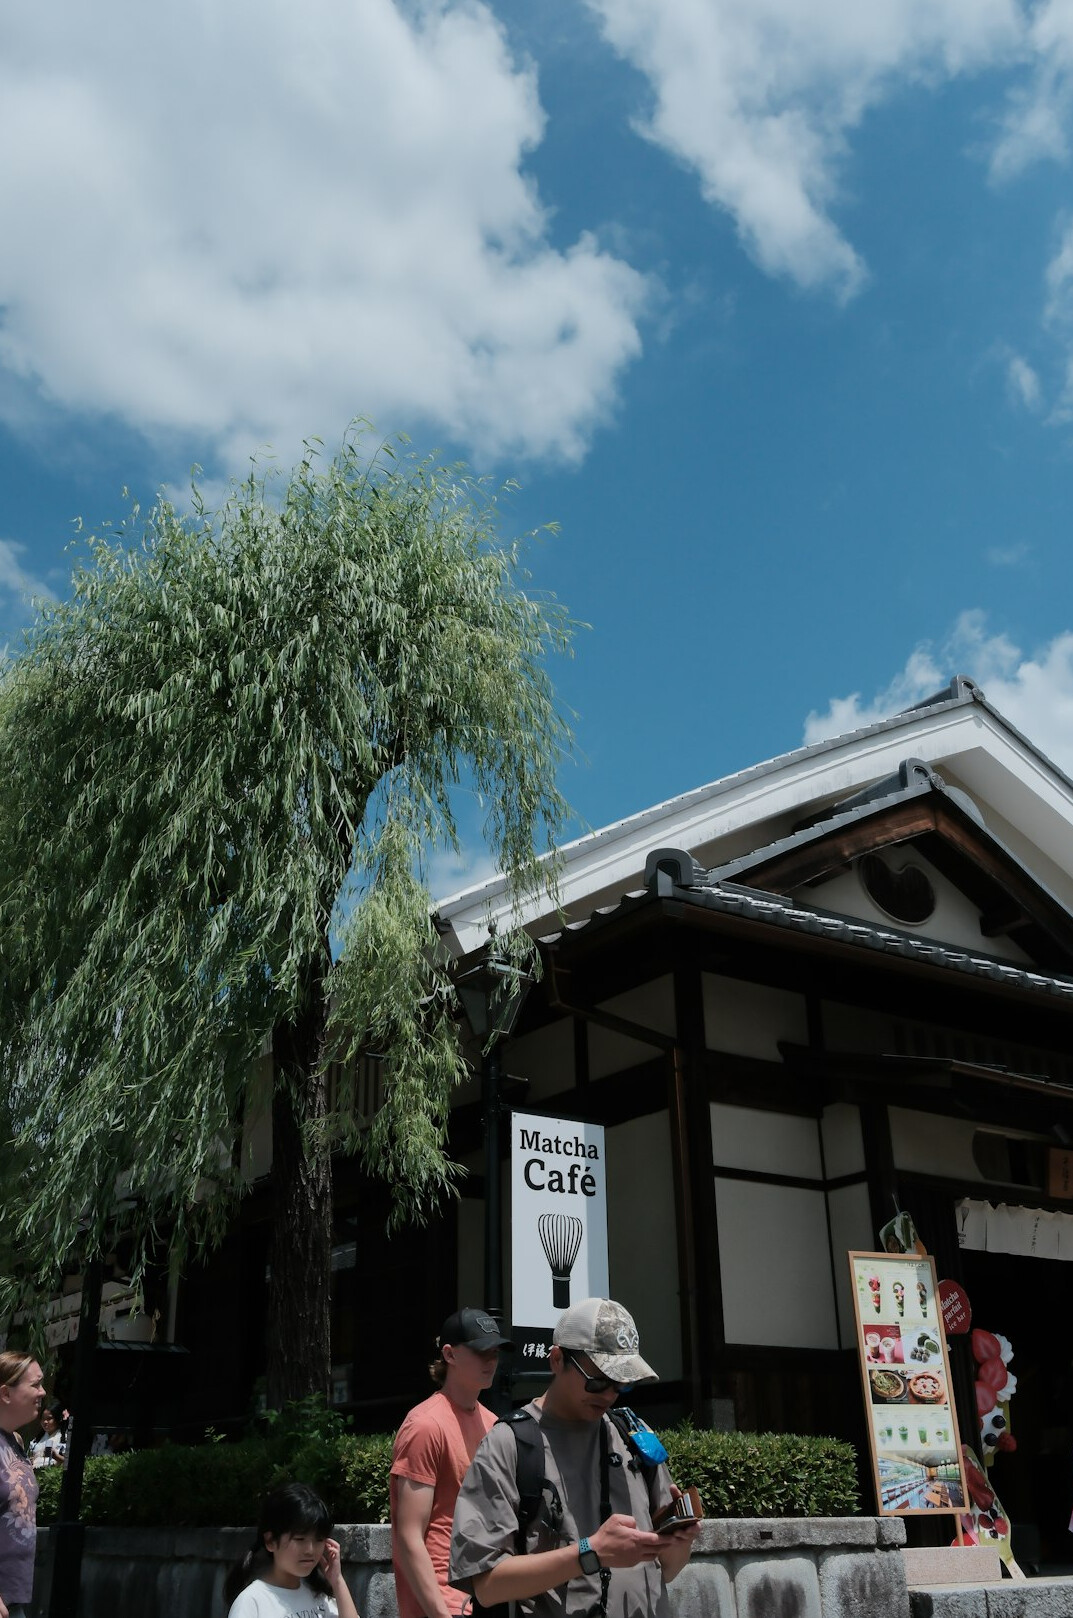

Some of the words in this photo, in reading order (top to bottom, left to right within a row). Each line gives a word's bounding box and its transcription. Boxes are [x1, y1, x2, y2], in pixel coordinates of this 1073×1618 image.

[520, 1129, 599, 1160] Matcha
[524, 1158, 596, 1197] Café
[944, 1301, 963, 1324] parfait
[948, 1321, 958, 1331] ice
[956, 1311, 966, 1323] bar
